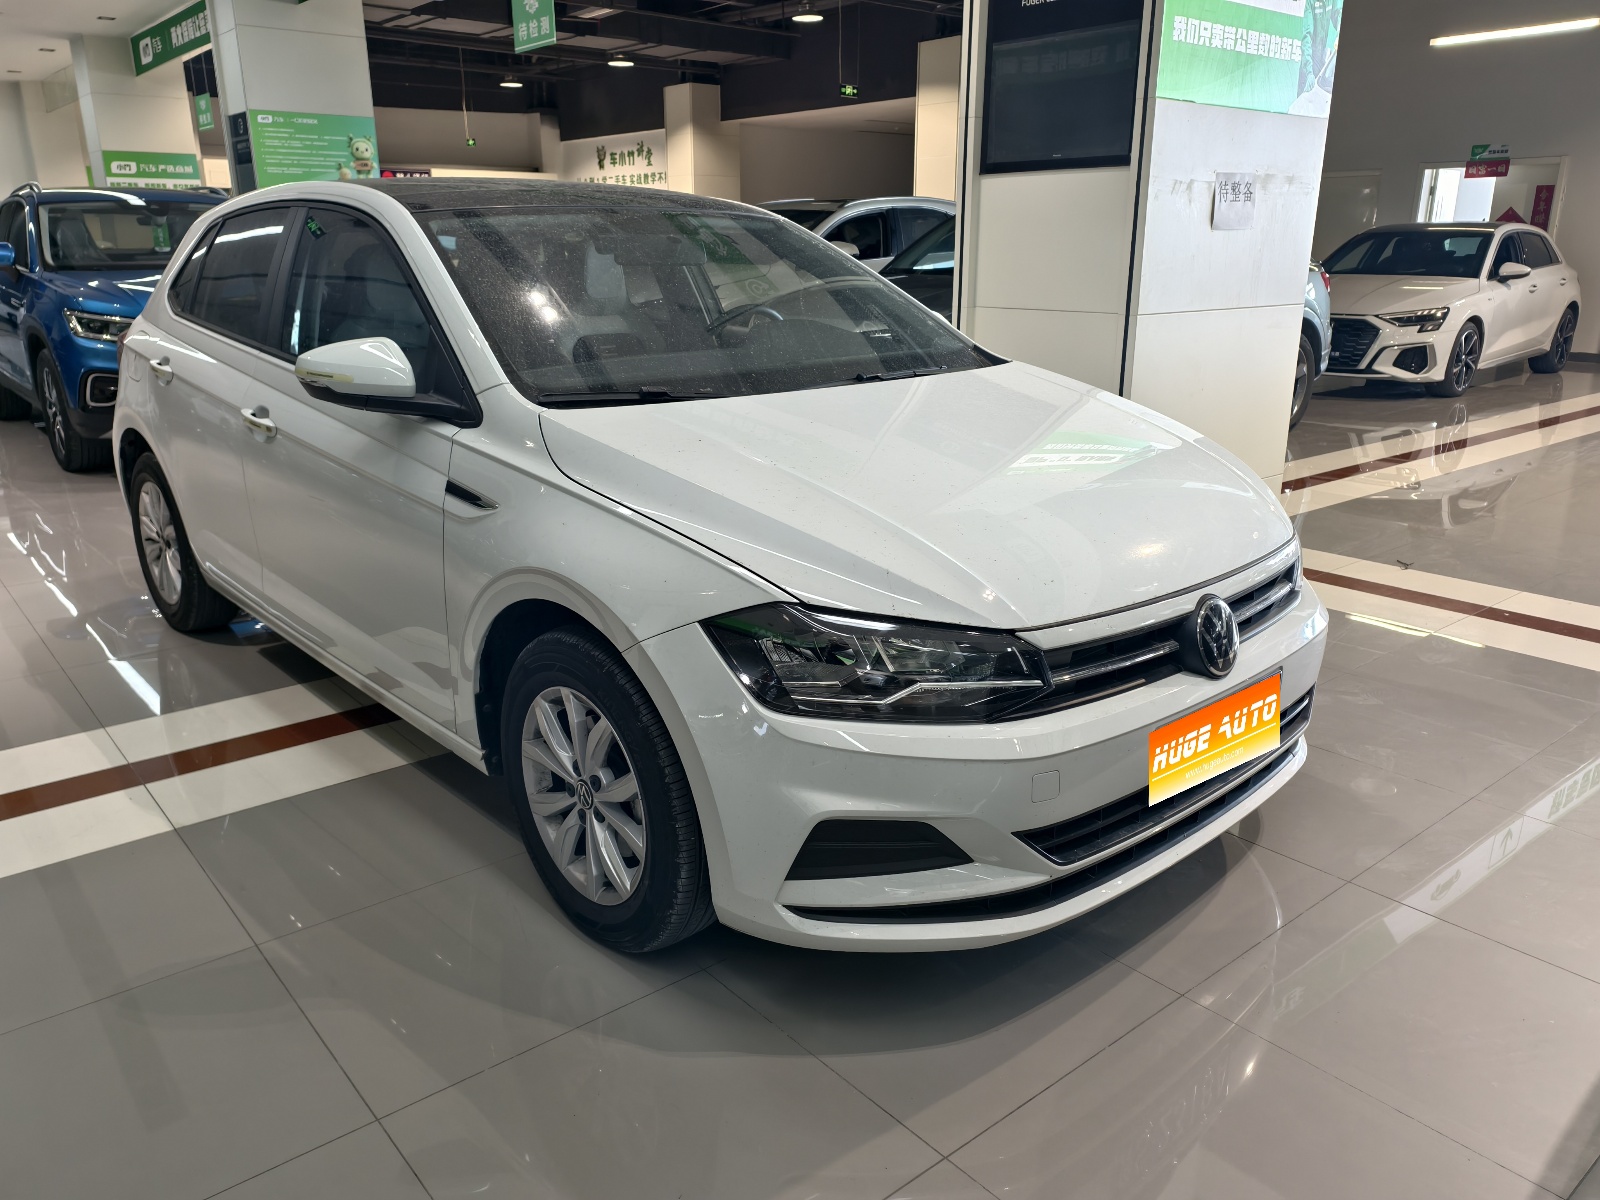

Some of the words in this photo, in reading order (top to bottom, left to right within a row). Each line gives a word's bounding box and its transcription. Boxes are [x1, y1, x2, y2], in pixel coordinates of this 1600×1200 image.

[518, 15, 550, 41] 待检测
[1173, 15, 1302, 62] 我们只卖带公里数的新车
[1217, 180, 1253, 203] 待整备
